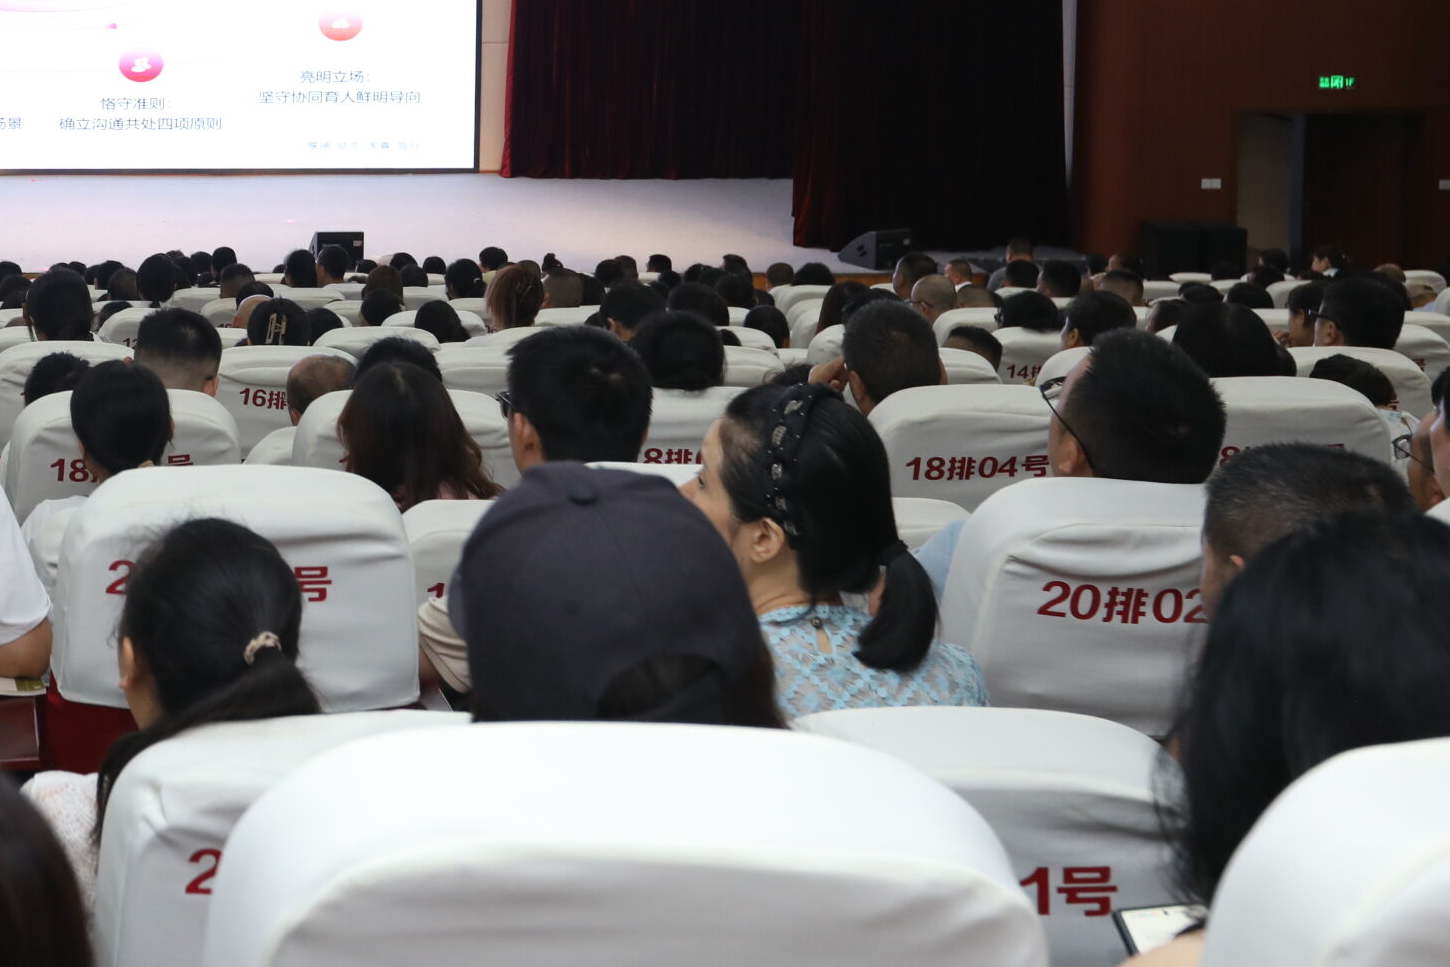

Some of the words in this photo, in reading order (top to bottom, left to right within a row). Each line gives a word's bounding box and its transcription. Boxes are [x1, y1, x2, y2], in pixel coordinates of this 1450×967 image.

[258, 90, 421, 104] 坚守协同育人鲜明导向
[59, 117, 222, 131] 确立沟通共处四项原则
[905, 454, 1050, 481] 18排04号
